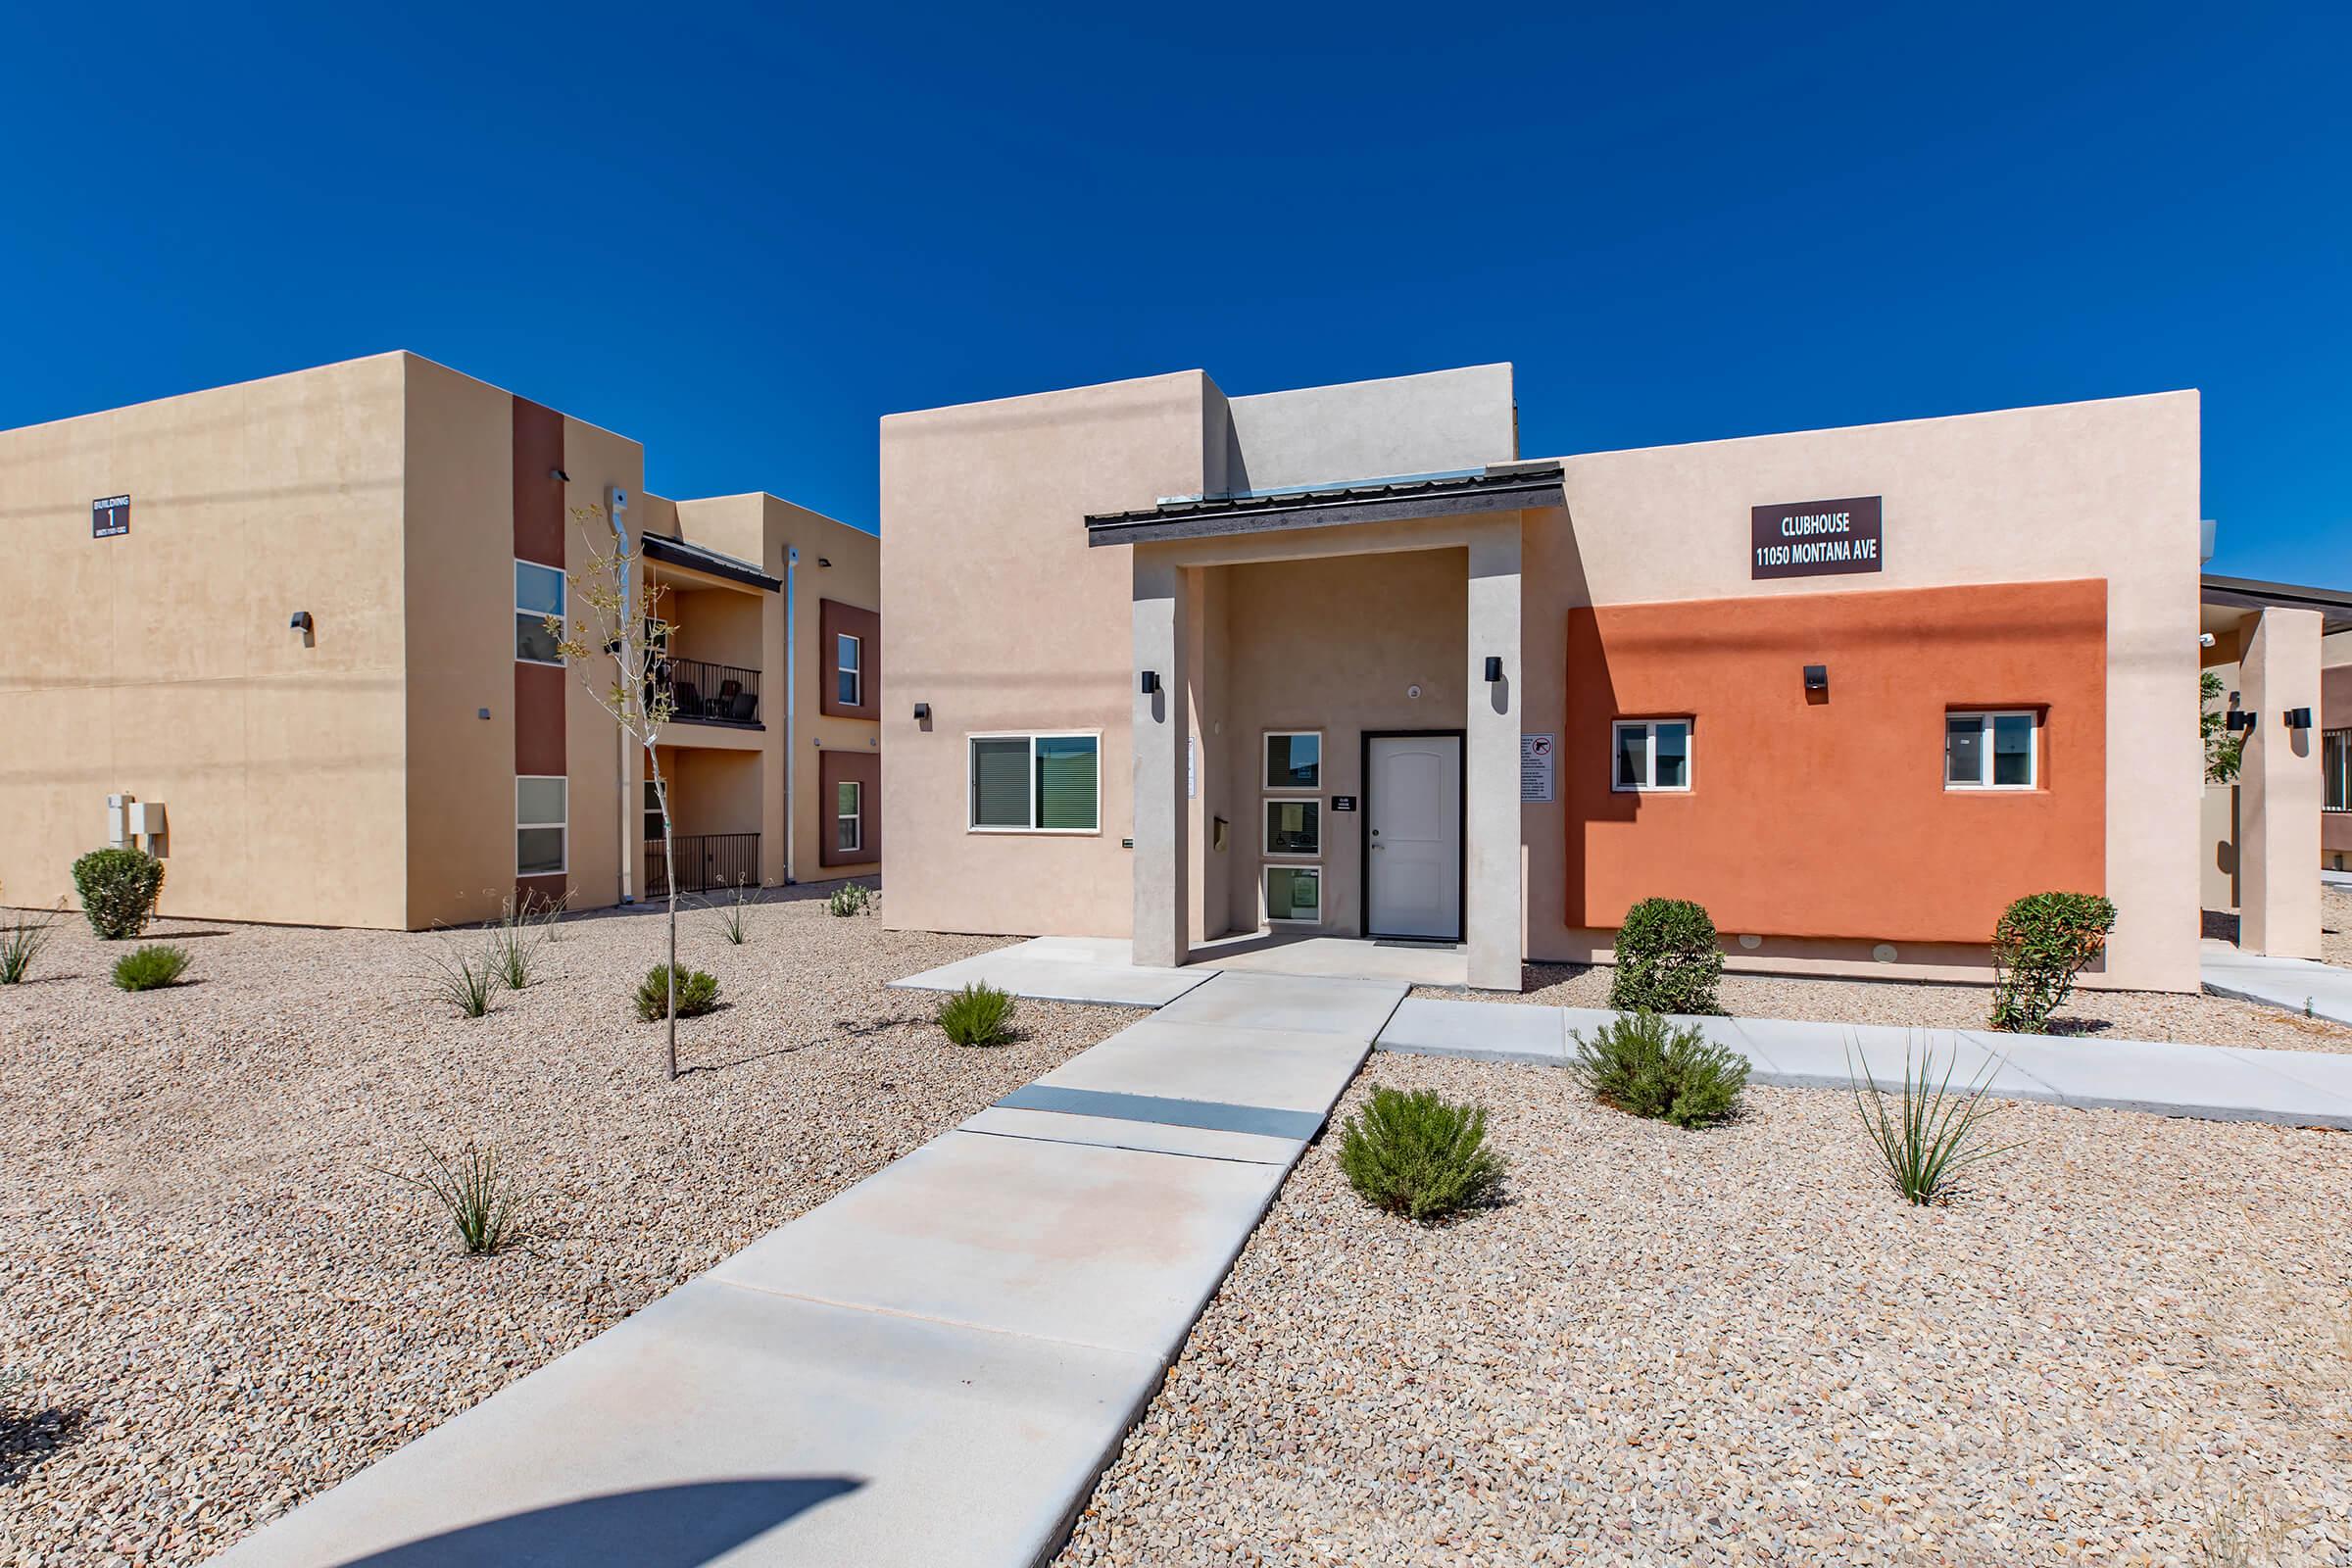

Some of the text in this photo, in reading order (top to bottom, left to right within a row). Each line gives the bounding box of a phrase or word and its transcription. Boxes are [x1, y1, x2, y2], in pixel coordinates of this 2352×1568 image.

[94, 496, 129, 511] BUILDING
[108, 509, 114, 526] 1
[1782, 513, 1850, 536] CLUBHOUSE
[1756, 538, 1877, 566] 11050 MONTANA AVE
